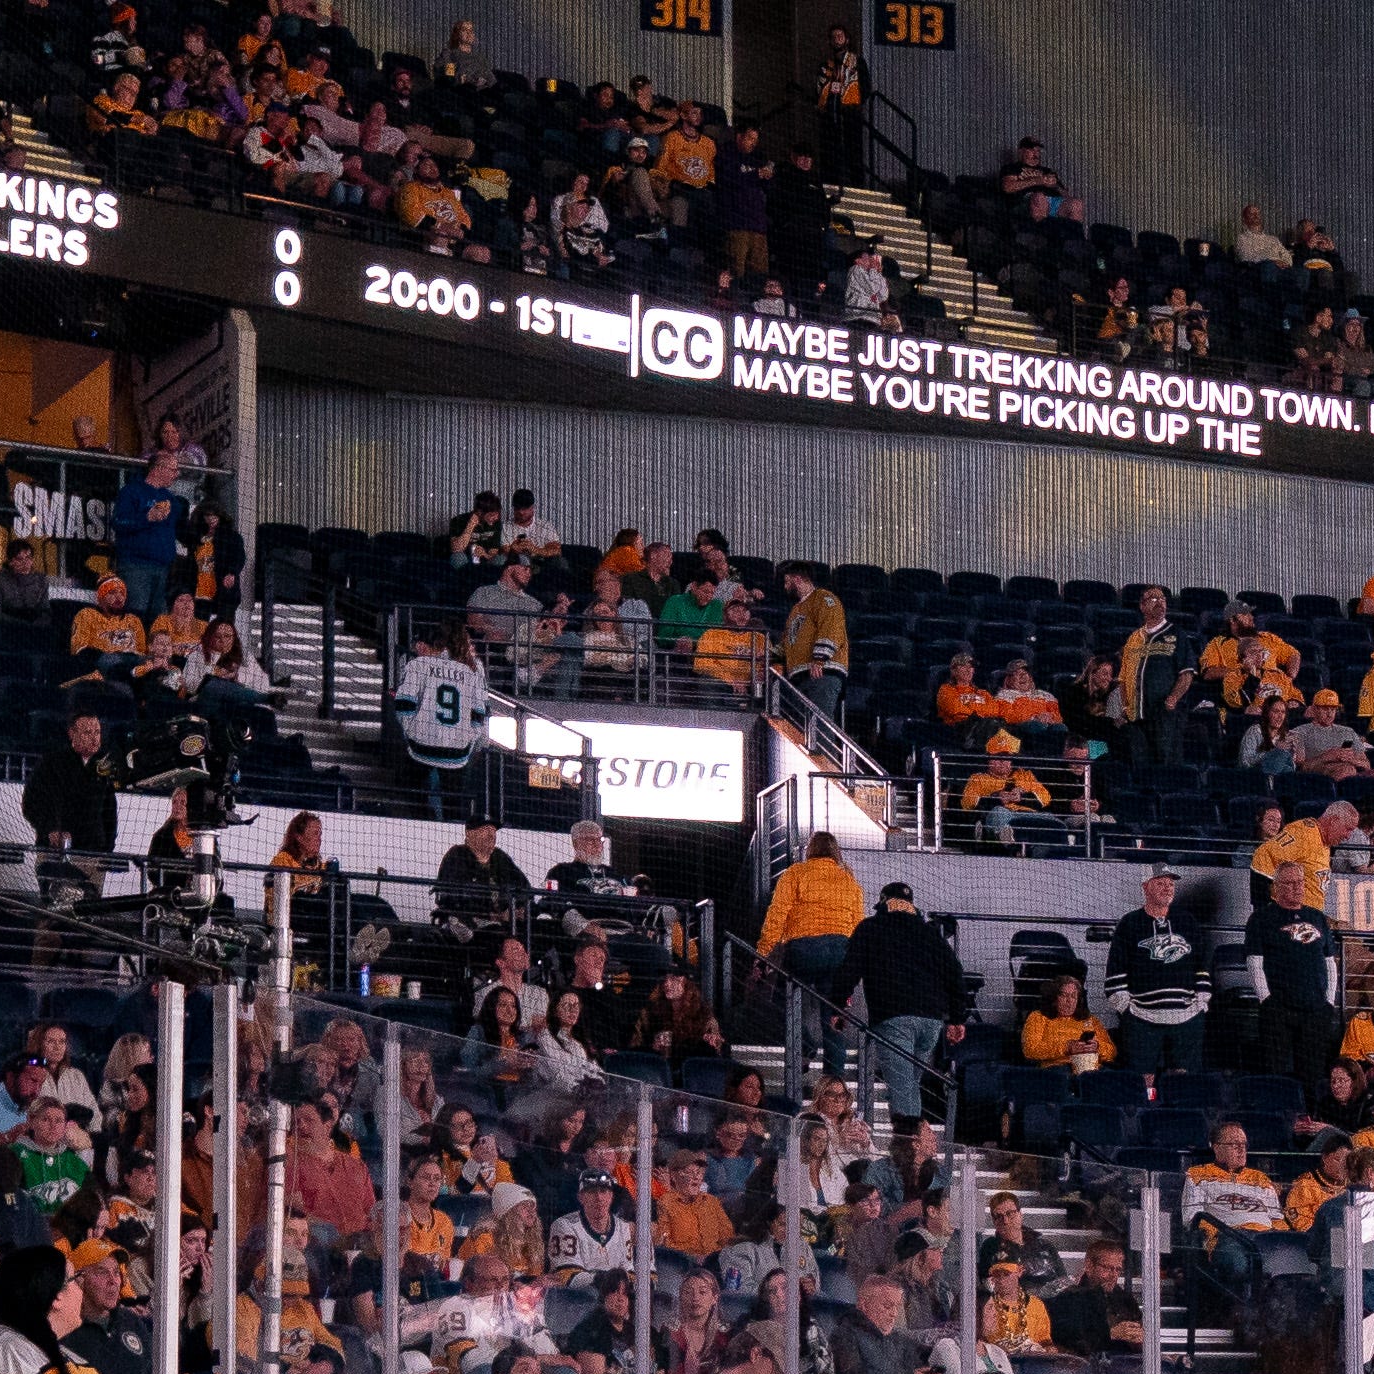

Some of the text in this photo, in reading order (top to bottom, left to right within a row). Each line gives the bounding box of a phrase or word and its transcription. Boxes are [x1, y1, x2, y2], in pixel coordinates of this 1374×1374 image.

[649, 0, 712, 31] 314
[885, 3, 946, 45] 313
[275, 229, 302, 265] 0
[274, 271, 301, 306] 0
[364, 265, 480, 320] 20:00
[733, 315, 850, 363] MAYBE
[857, 334, 943, 375] JUST
[947, 345, 1113, 398] TREKKING
[1117, 370, 1254, 417] AROUND
[1259, 388, 1361, 432] TOWN.
[733, 354, 1262, 456] MAYBE YOU'RE PICKING UP THE
[428, 666, 466, 683] KELLER
[436, 684, 461, 725] 9
